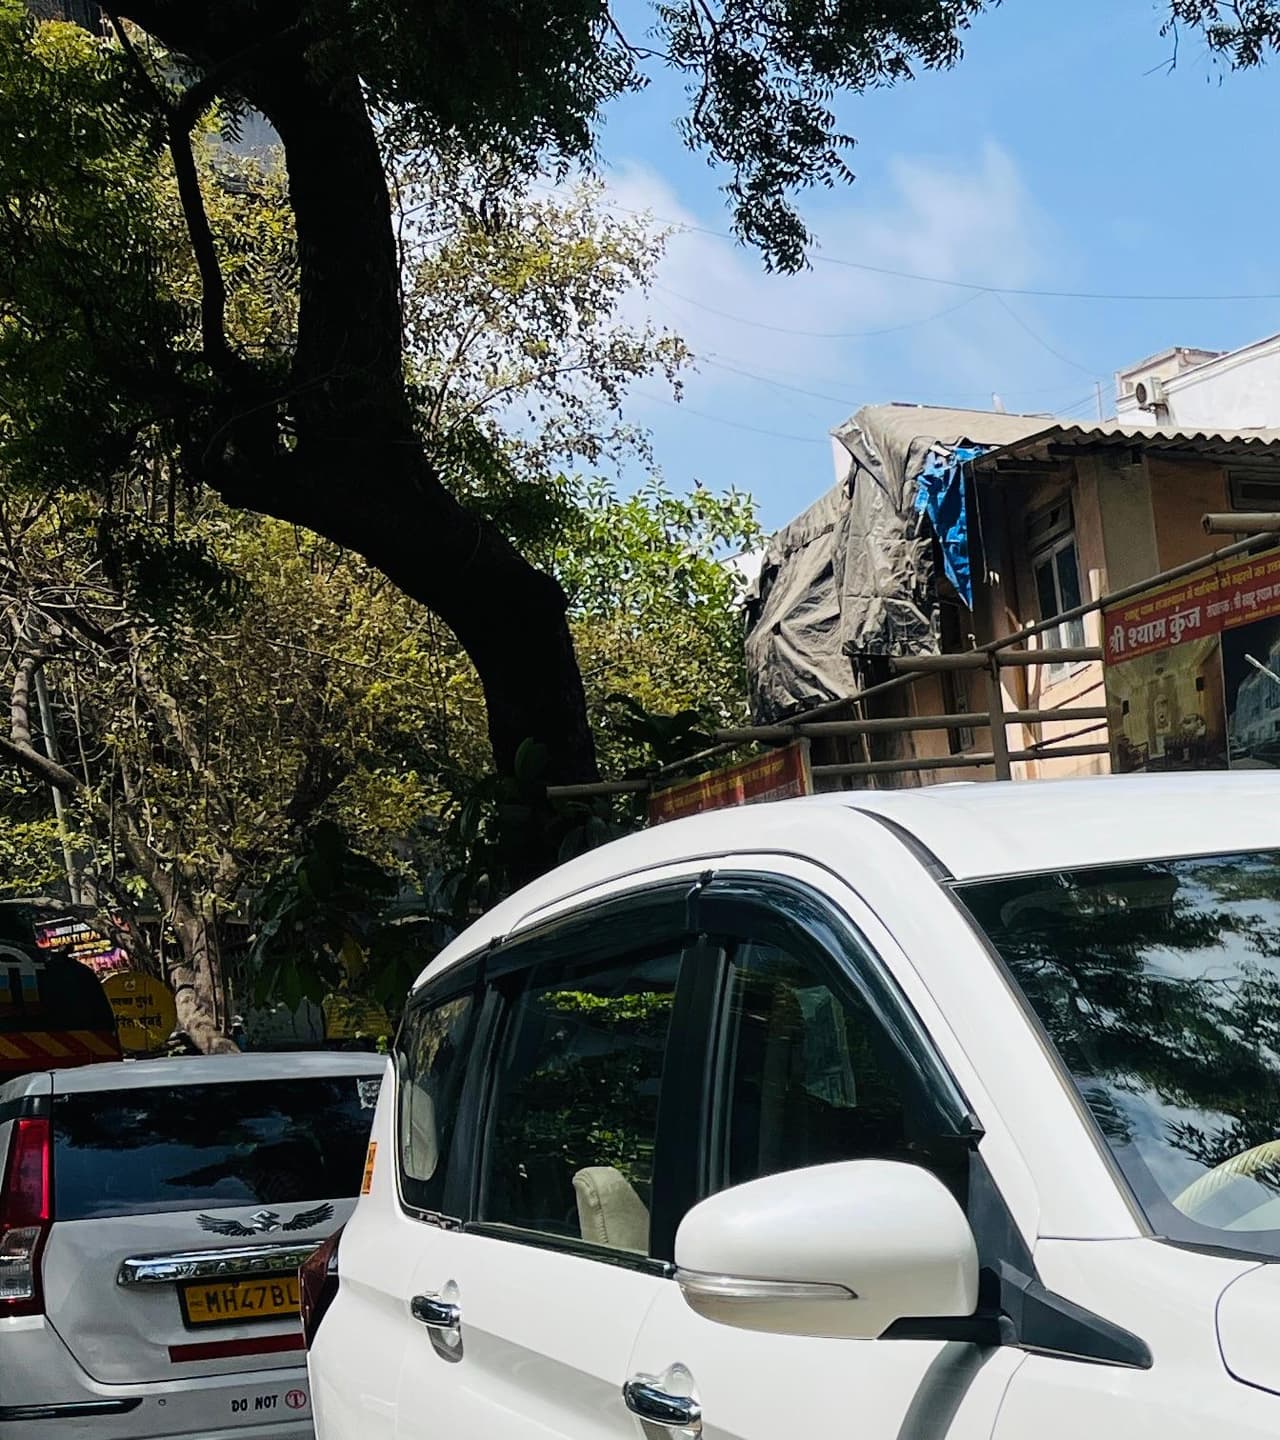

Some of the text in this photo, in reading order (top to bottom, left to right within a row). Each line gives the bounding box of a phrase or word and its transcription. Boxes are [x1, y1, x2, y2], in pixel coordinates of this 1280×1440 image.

[1128, 618, 1167, 648] श्याम
[1169, 606, 1201, 644] कुंज
[205, 1285, 300, 1313] MH47BL
[231, 1398, 248, 1412] DO
[255, 1395, 278, 1410] NOT
